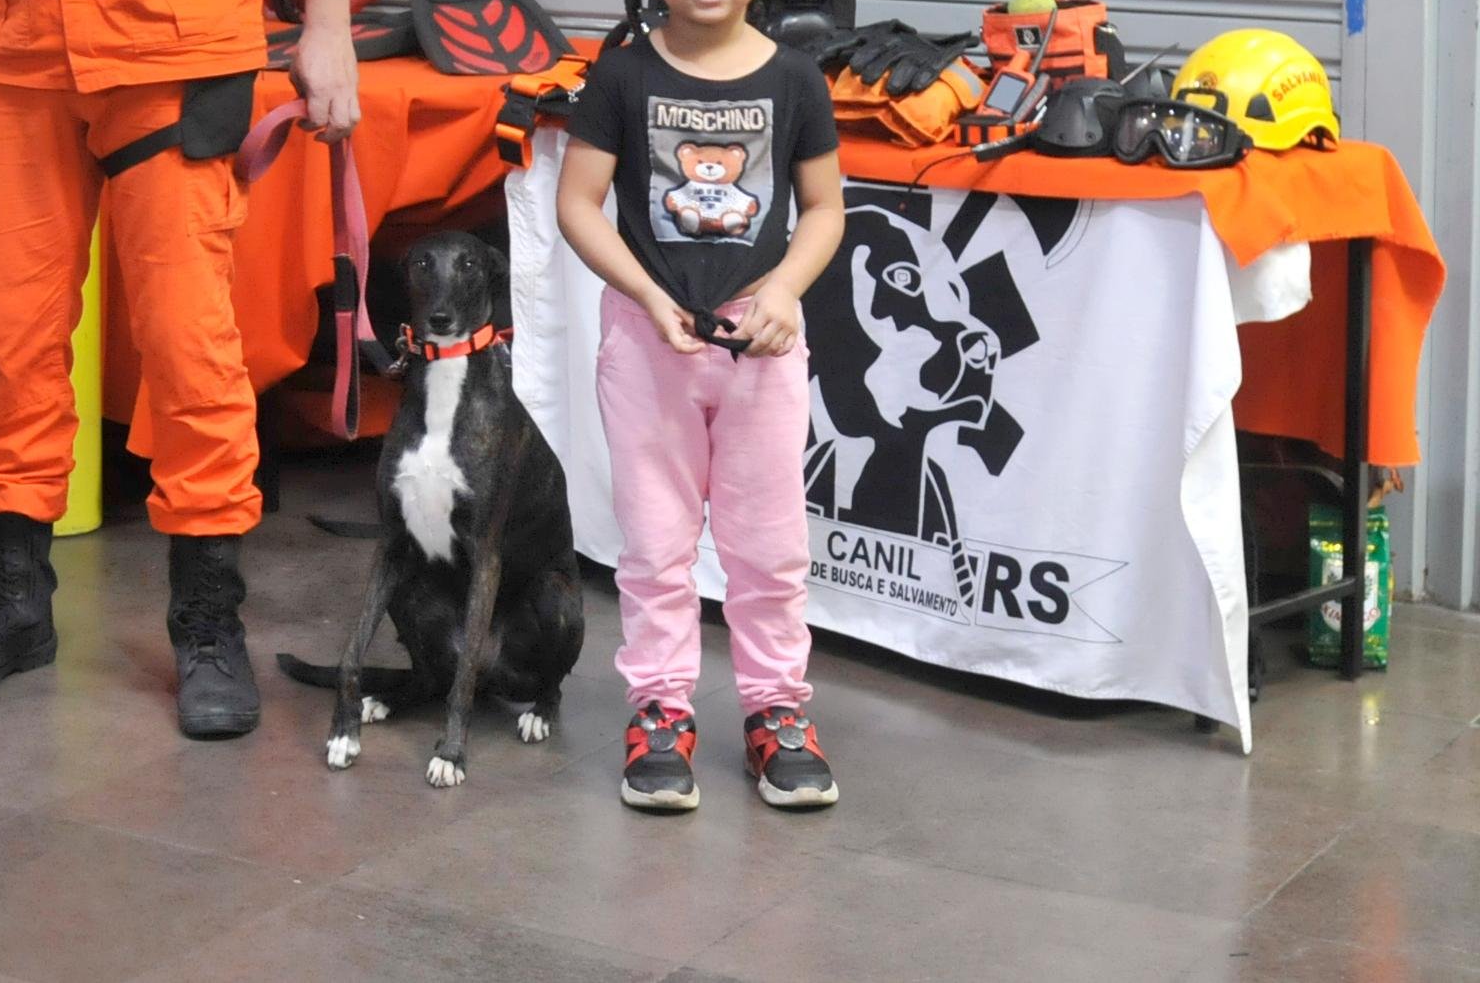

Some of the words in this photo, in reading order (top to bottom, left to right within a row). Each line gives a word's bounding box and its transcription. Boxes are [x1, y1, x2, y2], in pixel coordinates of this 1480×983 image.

[656, 104, 765, 131] MOSCHINO
[827, 530, 922, 581] CANIL
[810, 560, 828, 579] DE
[831, 566, 873, 592] BUSCA
[877, 578, 886, 595] E
[889, 581, 958, 617] SALVAMENTO
[981, 551, 1070, 624] RS
